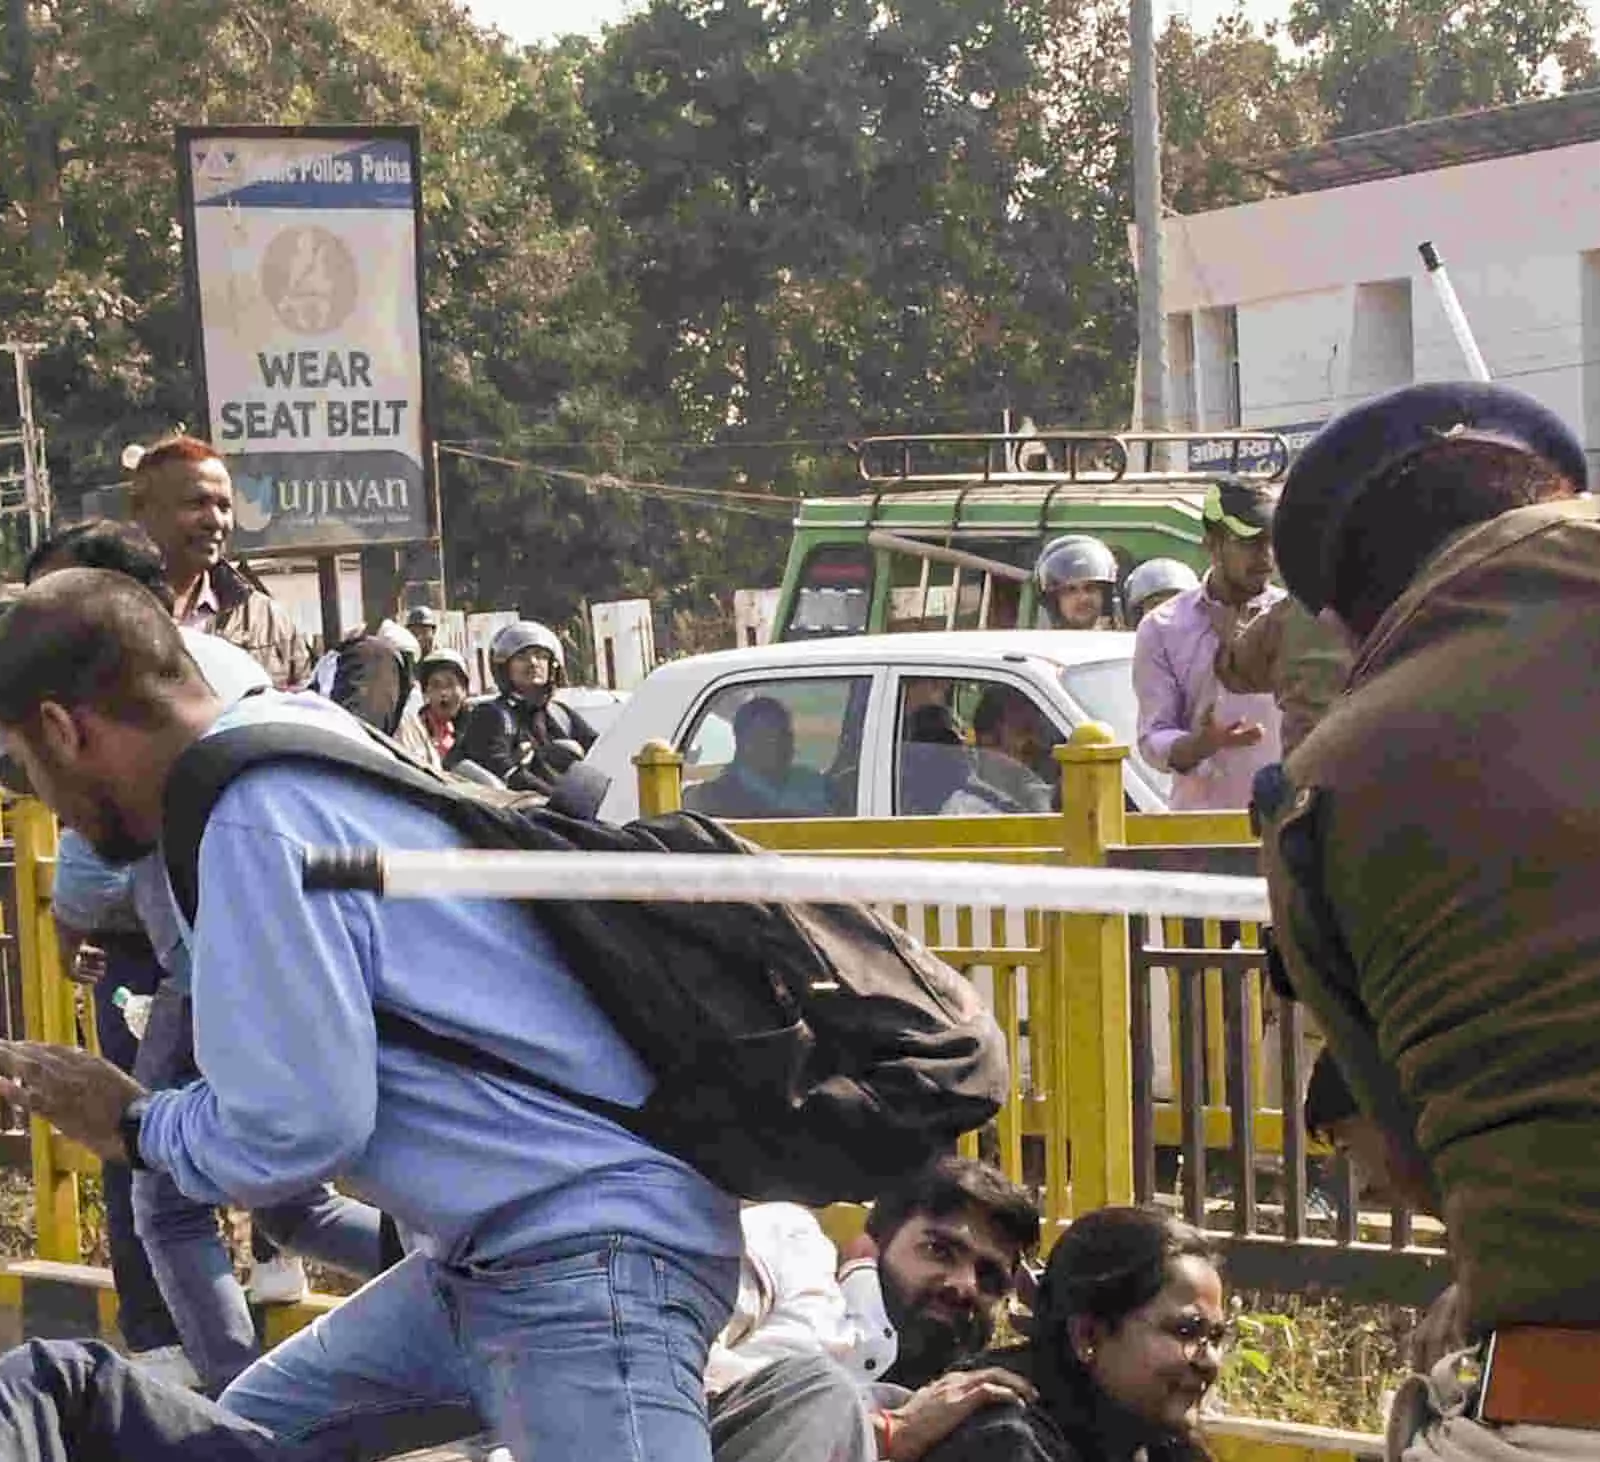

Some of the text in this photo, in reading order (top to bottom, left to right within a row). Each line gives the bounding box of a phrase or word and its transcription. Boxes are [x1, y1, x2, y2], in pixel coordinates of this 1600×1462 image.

[257, 351, 372, 389] WEAR
[221, 400, 408, 440] SEAT BELT
